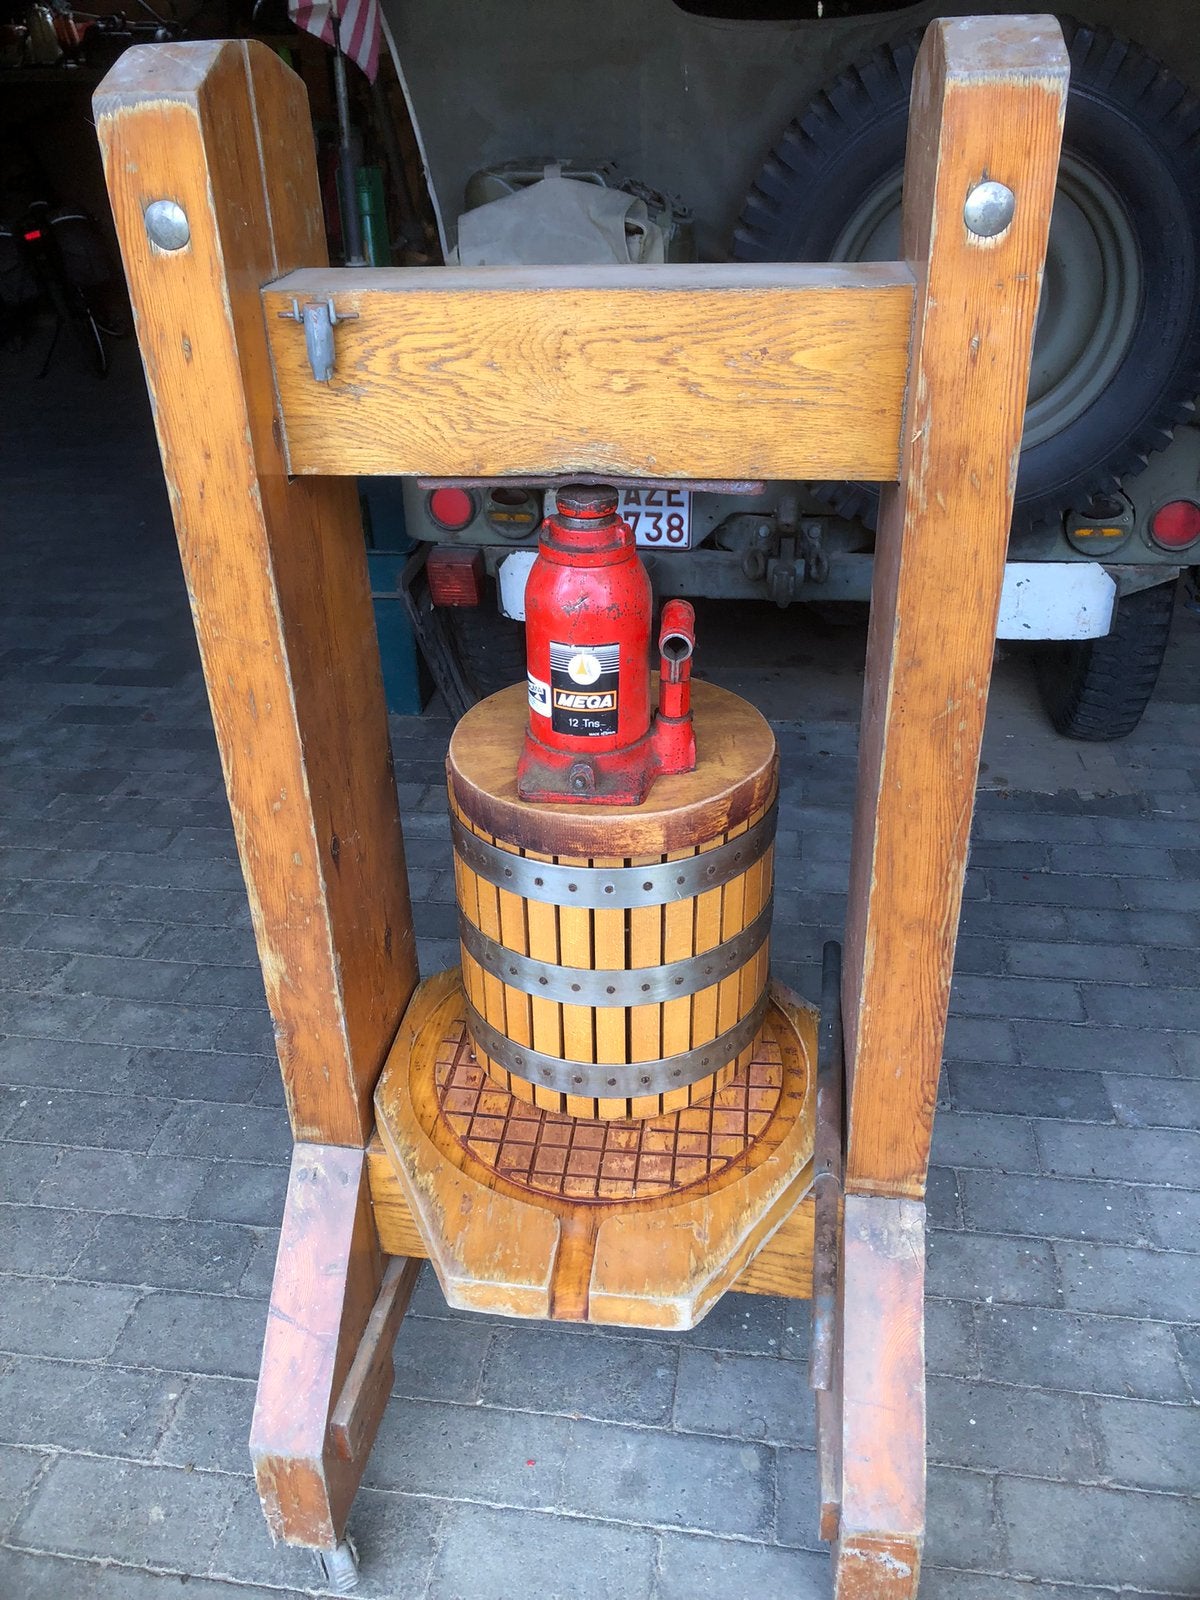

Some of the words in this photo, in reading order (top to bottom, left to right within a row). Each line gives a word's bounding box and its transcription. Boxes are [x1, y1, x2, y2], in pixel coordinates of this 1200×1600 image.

[623, 511, 684, 543] 738
[557, 693, 613, 709] MEGA
[568, 718, 579, 728] 12
[582, 718, 601, 728] Tns
